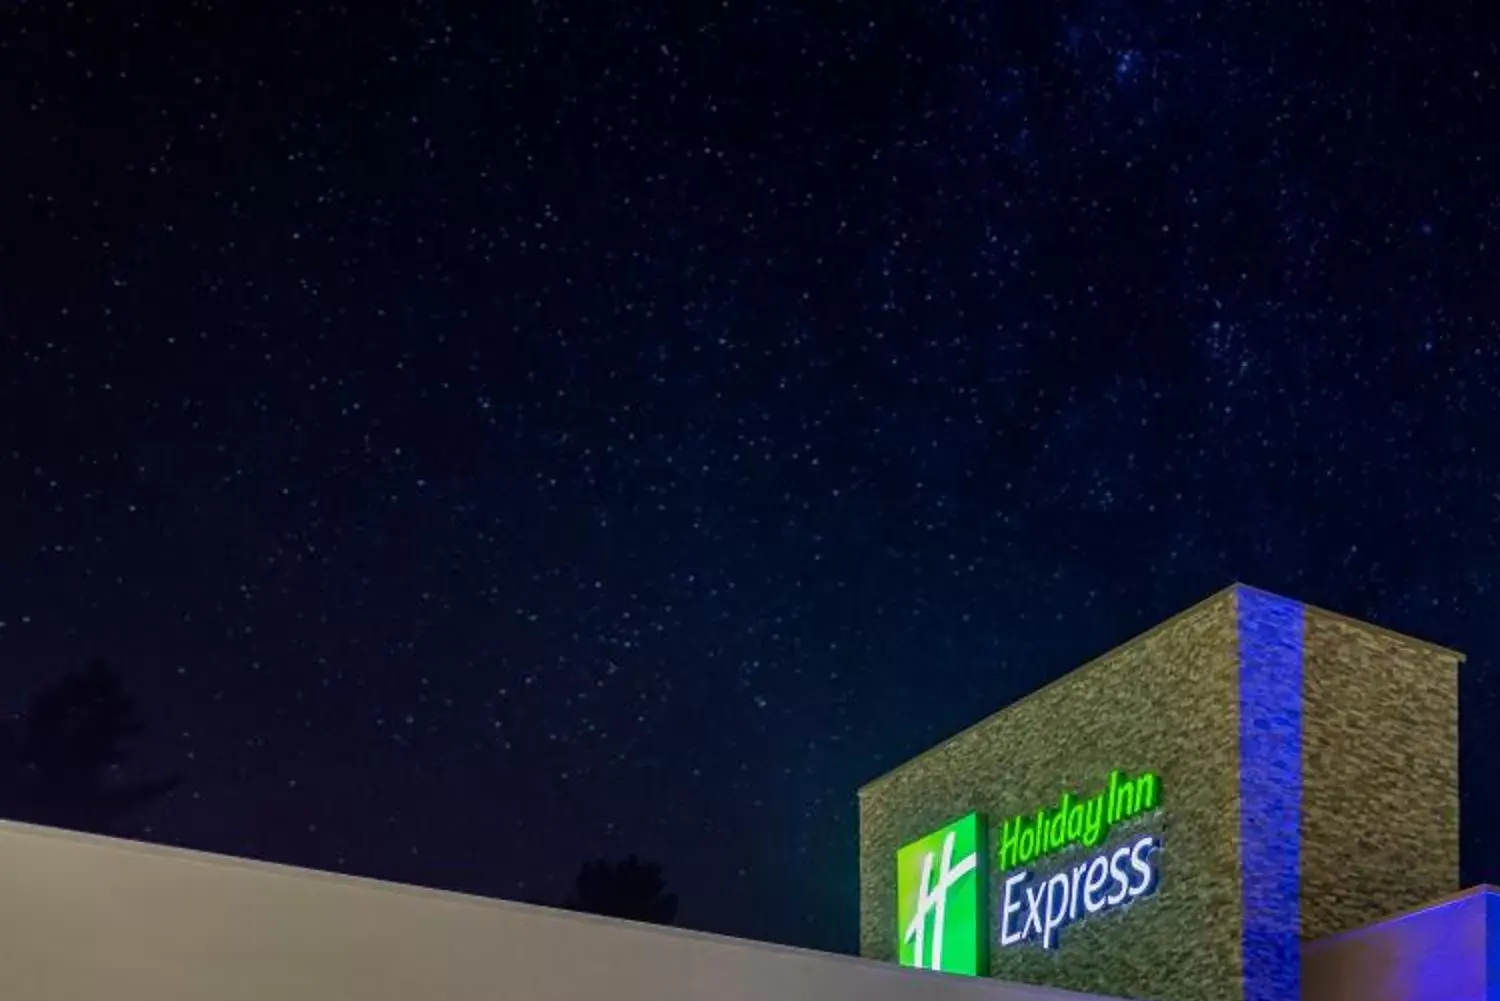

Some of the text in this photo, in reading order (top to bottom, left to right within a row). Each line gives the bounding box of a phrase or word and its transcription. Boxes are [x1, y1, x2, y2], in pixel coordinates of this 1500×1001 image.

[999, 770, 1157, 871] Holiday Inn
[1001, 837, 1153, 949] Express
